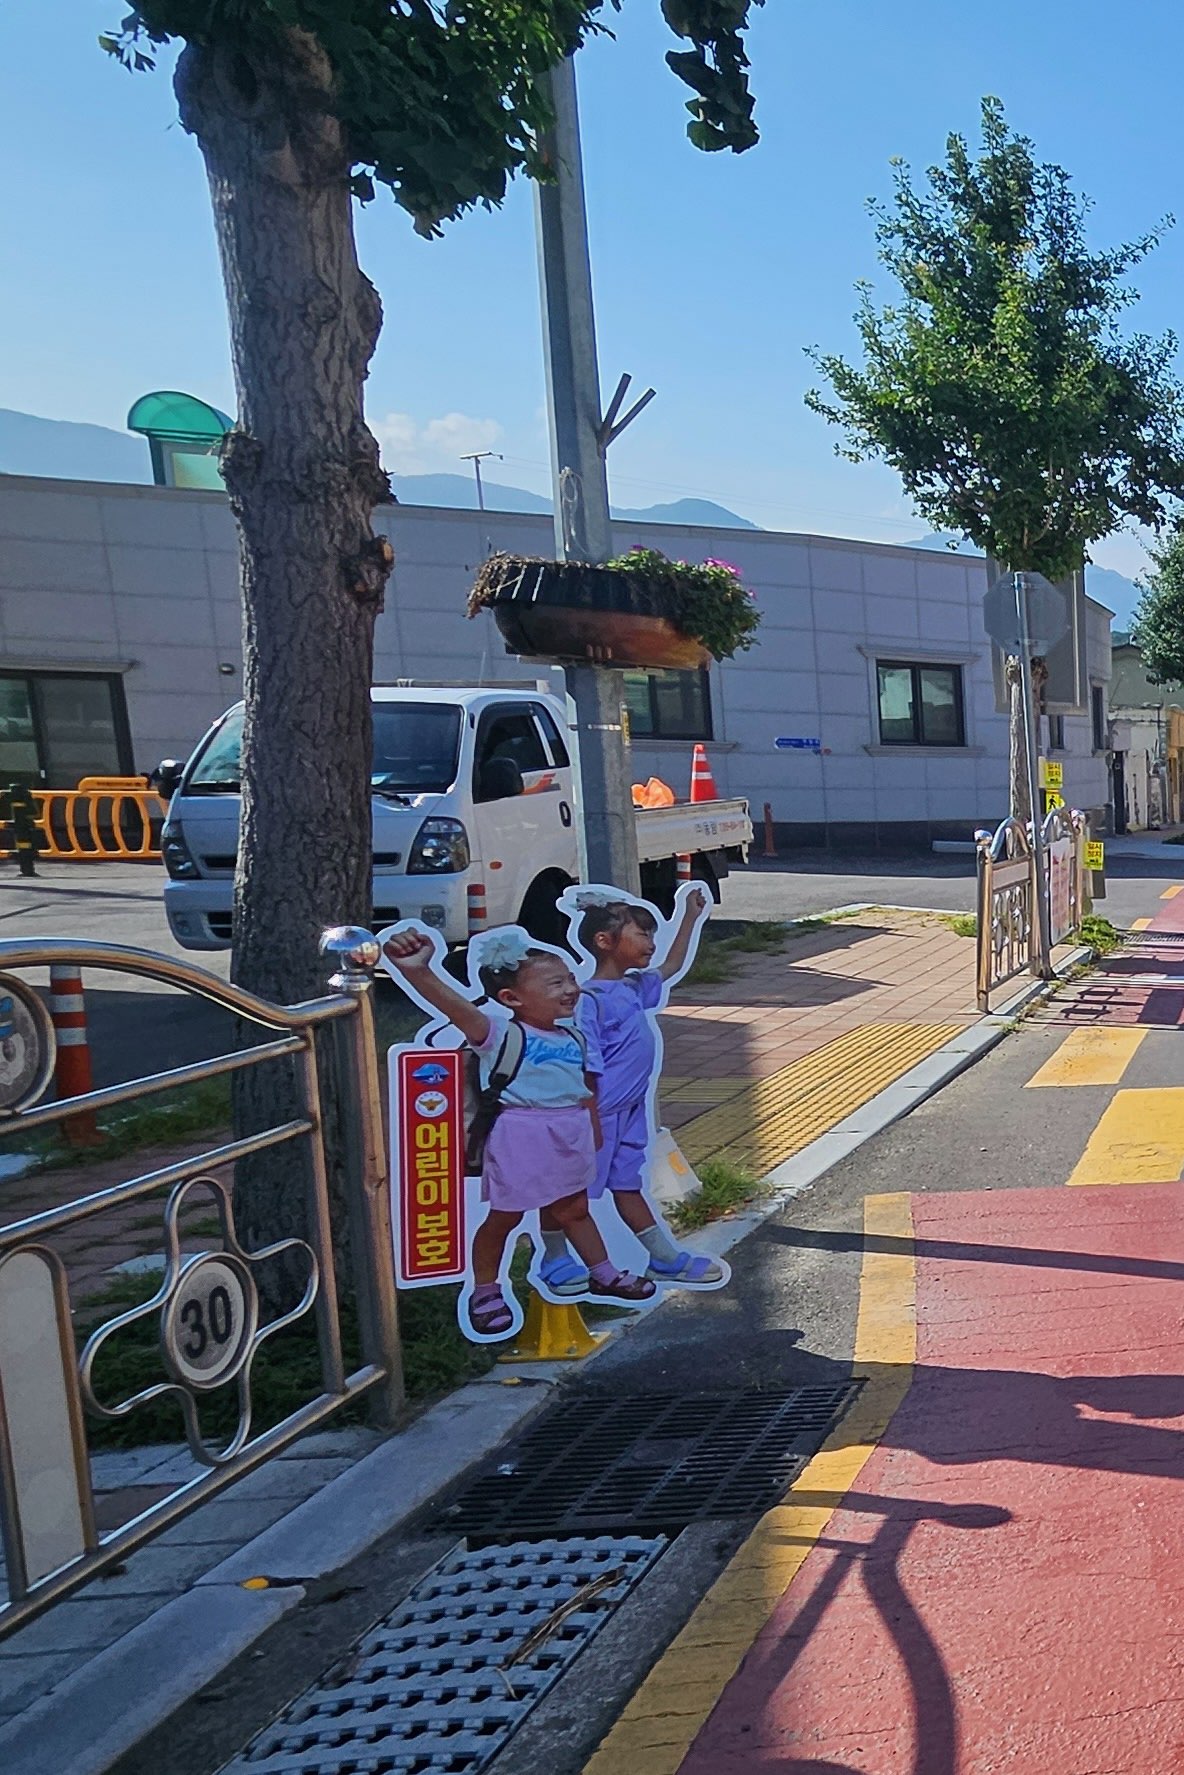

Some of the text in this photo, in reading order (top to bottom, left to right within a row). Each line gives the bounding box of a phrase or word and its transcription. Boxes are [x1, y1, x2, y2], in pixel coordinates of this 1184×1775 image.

[415, 1121, 450, 1267] 어린이 보호
[181, 1285, 232, 1359] 30
